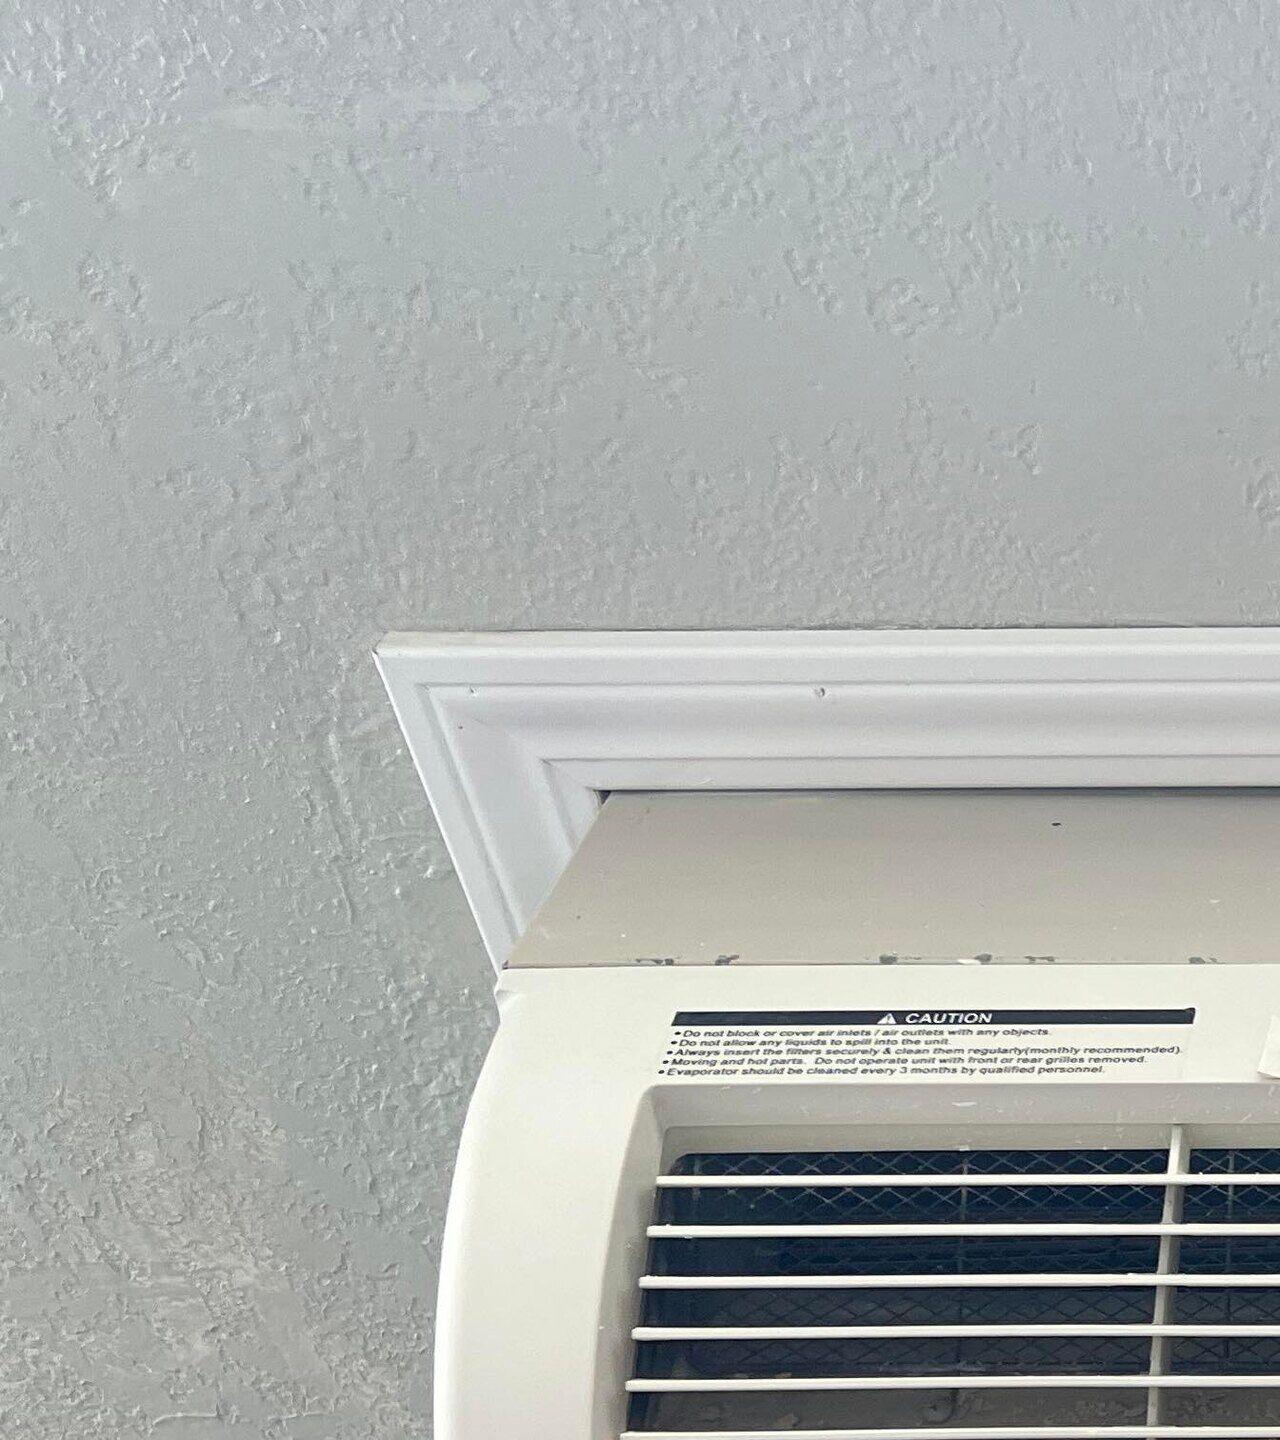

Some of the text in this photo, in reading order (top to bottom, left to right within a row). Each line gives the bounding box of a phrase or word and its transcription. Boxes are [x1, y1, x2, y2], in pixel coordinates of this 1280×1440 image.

[905, 1012, 993, 1024] CAUTION
[683, 1029, 701, 1038] Do
[703, 1029, 724, 1037] not
[726, 1029, 760, 1037] block
[900, 1028, 945, 1036] outlets
[947, 1028, 974, 1036] with
[976, 1029, 1000, 1037] any
[679, 1038, 697, 1047] Do
[699, 1039, 721, 1047] not
[722, 1039, 757, 1047] allow
[758, 1040, 783, 1048] any
[785, 1038, 827, 1047] liquids
[845, 1038, 873, 1047] spill
[873, 1038, 899, 1046] into
[901, 1038, 921, 1046] the
[674, 1048, 721, 1058] Always
[723, 1048, 761, 1056] insert
[762, 1048, 783, 1056] the
[825, 1048, 879, 1057] securely
[882, 1047, 891, 1056] &
[894, 1047, 930, 1055] clean
[932, 1047, 965, 1055] them
[670, 1058, 718, 1067] Moving
[719, 1057, 745, 1066] and
[747, 1057, 768, 1066] hot
[814, 1056, 833, 1065] Do
[834, 1057, 856, 1065] not
[858, 1057, 909, 1066] operate
[911, 1056, 937, 1065] unit
[938, 1056, 965, 1064] with
[967, 1056, 998, 1064] front
[1045, 1055, 1085, 1066] grilles
[667, 1067, 739, 1078] Evaporator
[741, 1067, 785, 1076] should
[787, 1067, 803, 1075] be
[806, 1066, 858, 1075] cleaned
[860, 1067, 897, 1076] every
[899, 1066, 908, 1074] 3
[909, 1066, 957, 1075] months
[960, 1066, 977, 1076] by
[979, 1065, 1035, 1076] qualified
